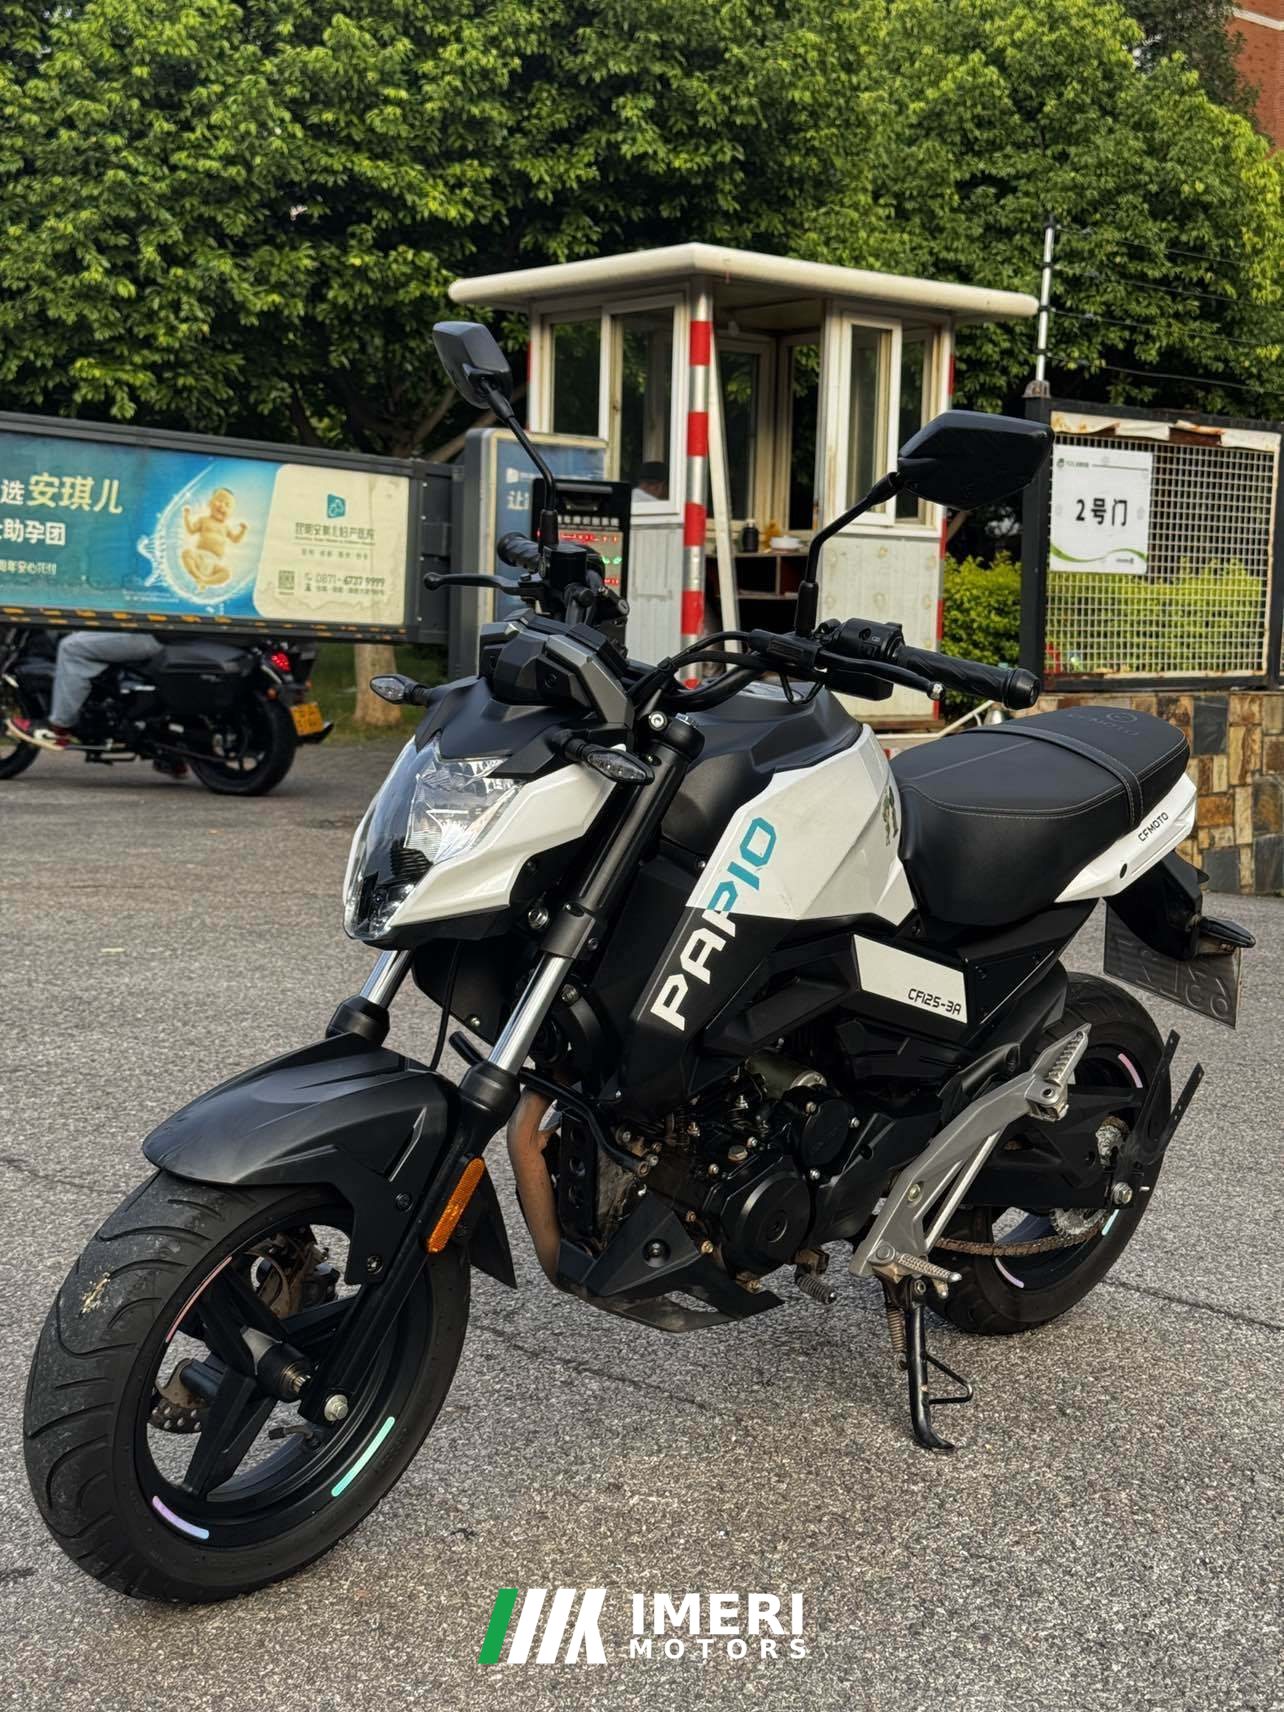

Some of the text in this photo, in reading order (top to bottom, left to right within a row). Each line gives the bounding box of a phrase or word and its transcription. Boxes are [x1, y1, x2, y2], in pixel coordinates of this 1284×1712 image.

[1075, 497, 1128, 526] 2号门
[0, 518, 66, 546] 助孕团
[1137, 811, 1169, 842] CFMOTO
[650, 817, 777, 1031] PAPIO
